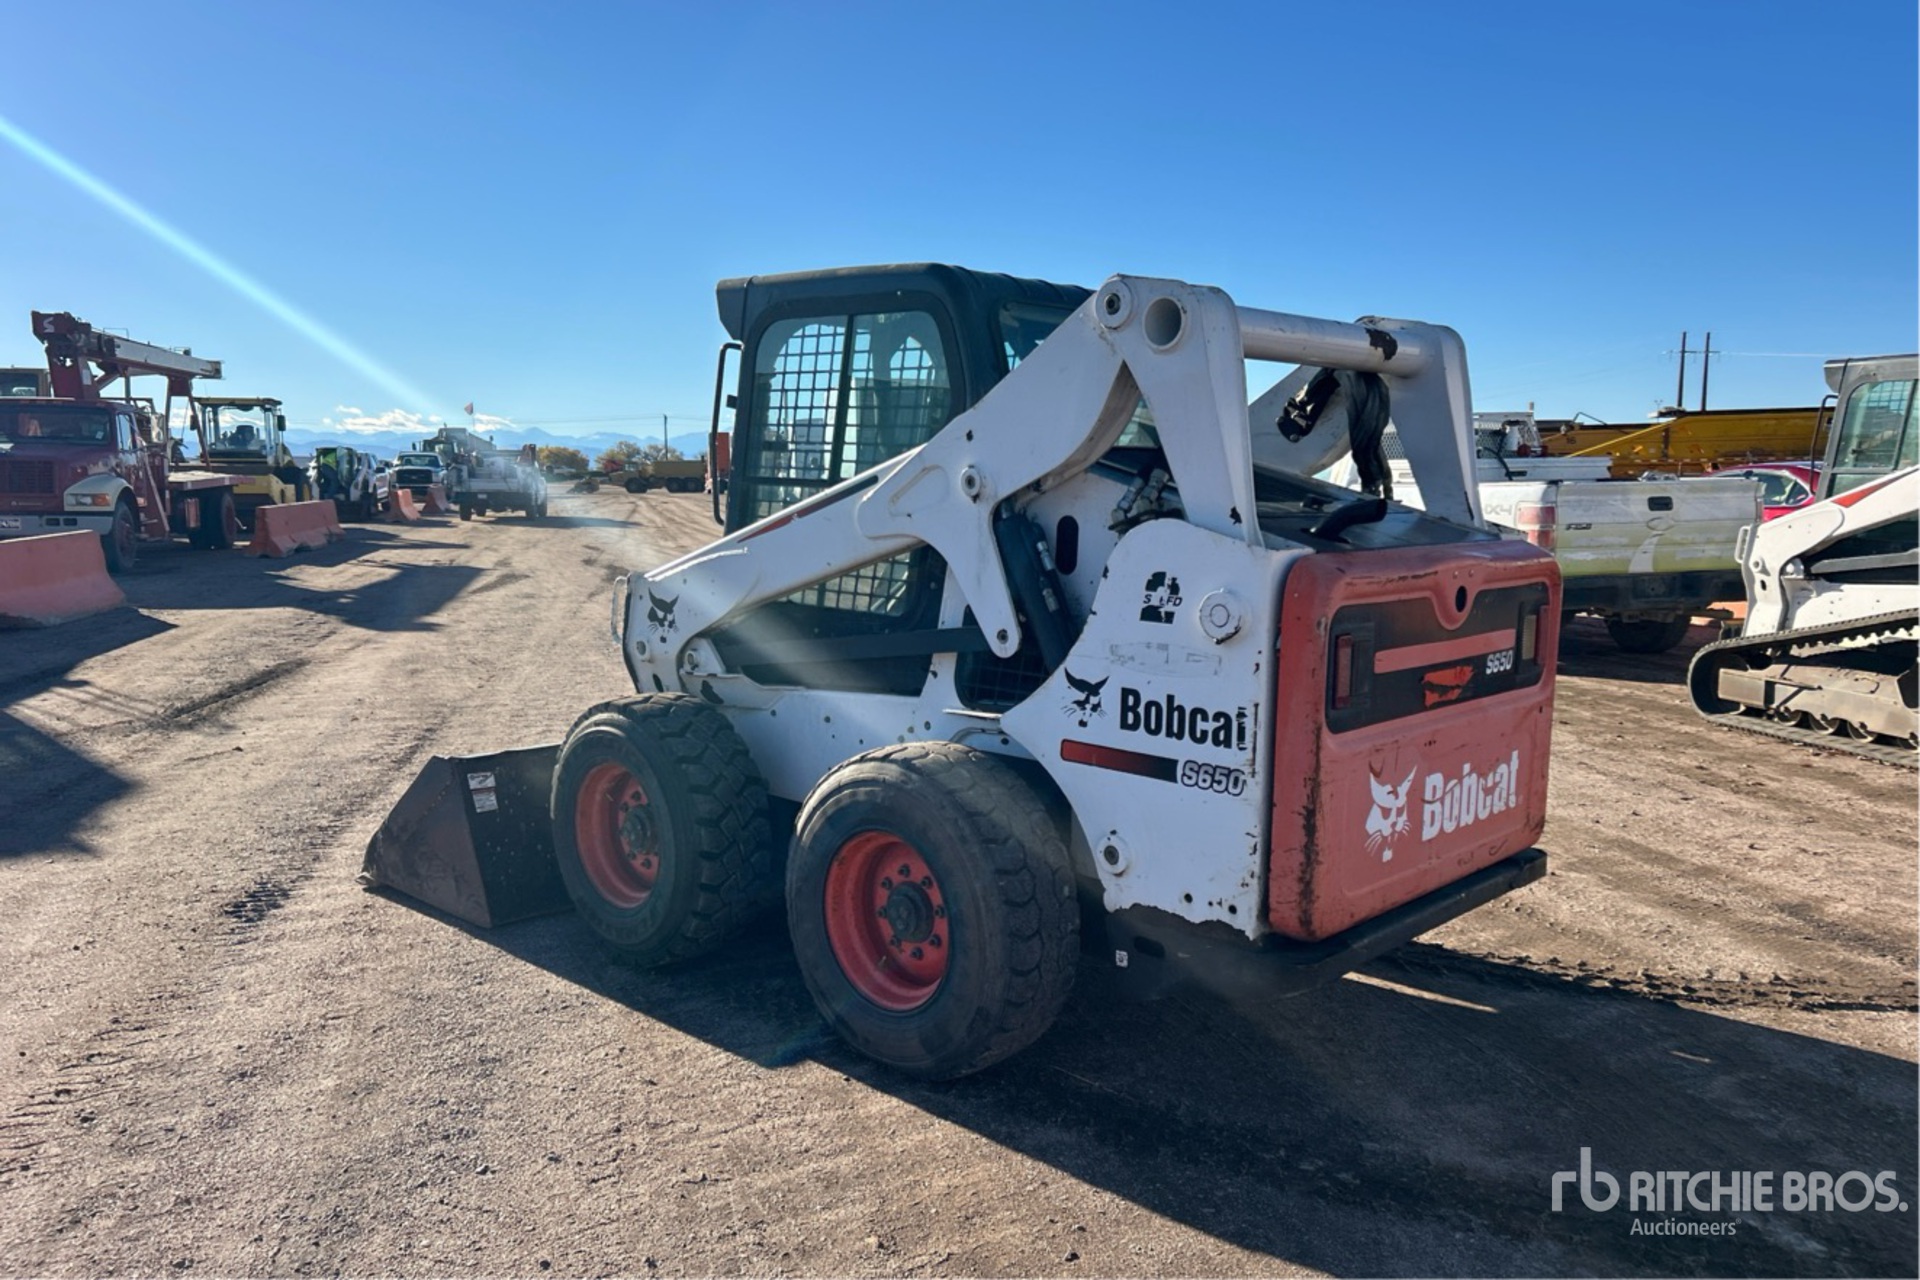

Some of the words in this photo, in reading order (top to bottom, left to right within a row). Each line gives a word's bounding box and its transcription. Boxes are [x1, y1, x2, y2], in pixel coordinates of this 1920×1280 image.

[1485, 649, 1514, 675] S650
[1119, 686, 1248, 751] Bobcat
[1181, 759, 1247, 797] S650
[1422, 749, 1519, 842] Bobcat
